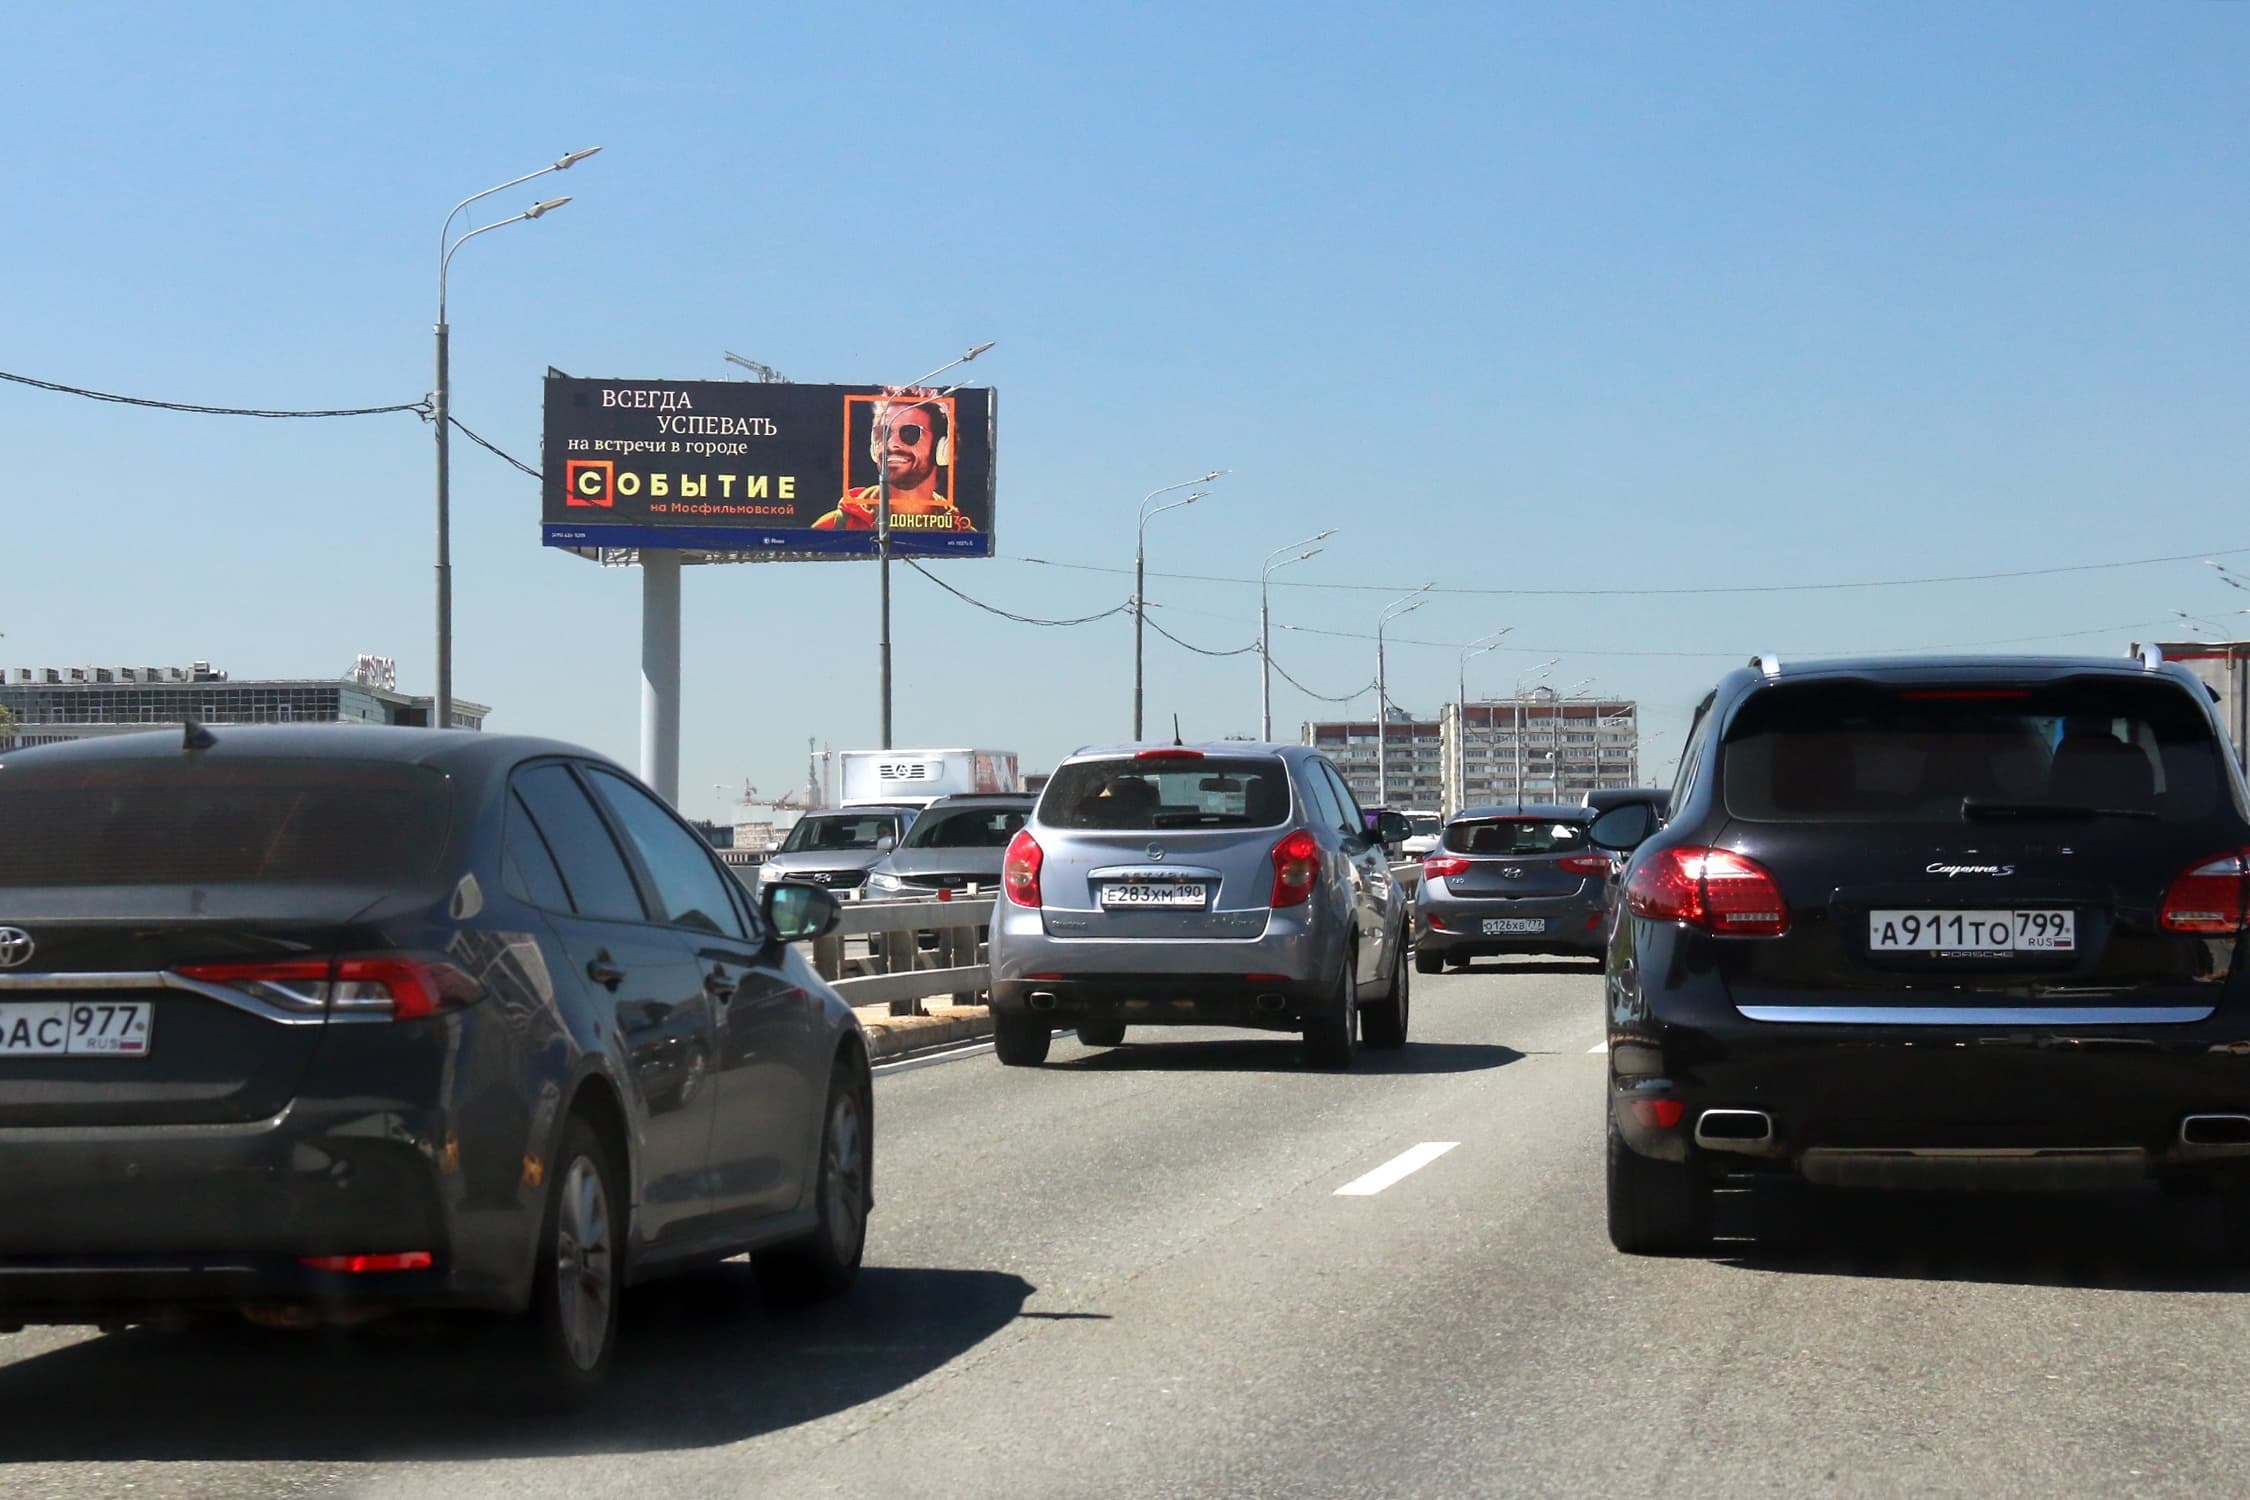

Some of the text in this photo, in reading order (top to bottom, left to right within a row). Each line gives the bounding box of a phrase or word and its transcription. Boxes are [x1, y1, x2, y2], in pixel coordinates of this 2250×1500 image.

[602, 389, 693, 412] ВСЕГДА
[656, 415, 778, 436] УСПЕВАТЬ
[567, 439, 748, 456] на встречи в городе
[578, 471, 795, 499] СОБЫТИЕ
[650, 503, 794, 516] на Мосфильмовской
[889, 512, 953, 528] ДОНСТРОЙ
[1926, 863, 1999, 878] Cayenne
[1177, 886, 1201, 897] 190
[1881, 913, 2065, 945] А911ТО 799
[2028, 938, 2052, 946] RUS
[73, 1006, 138, 1036] 977
